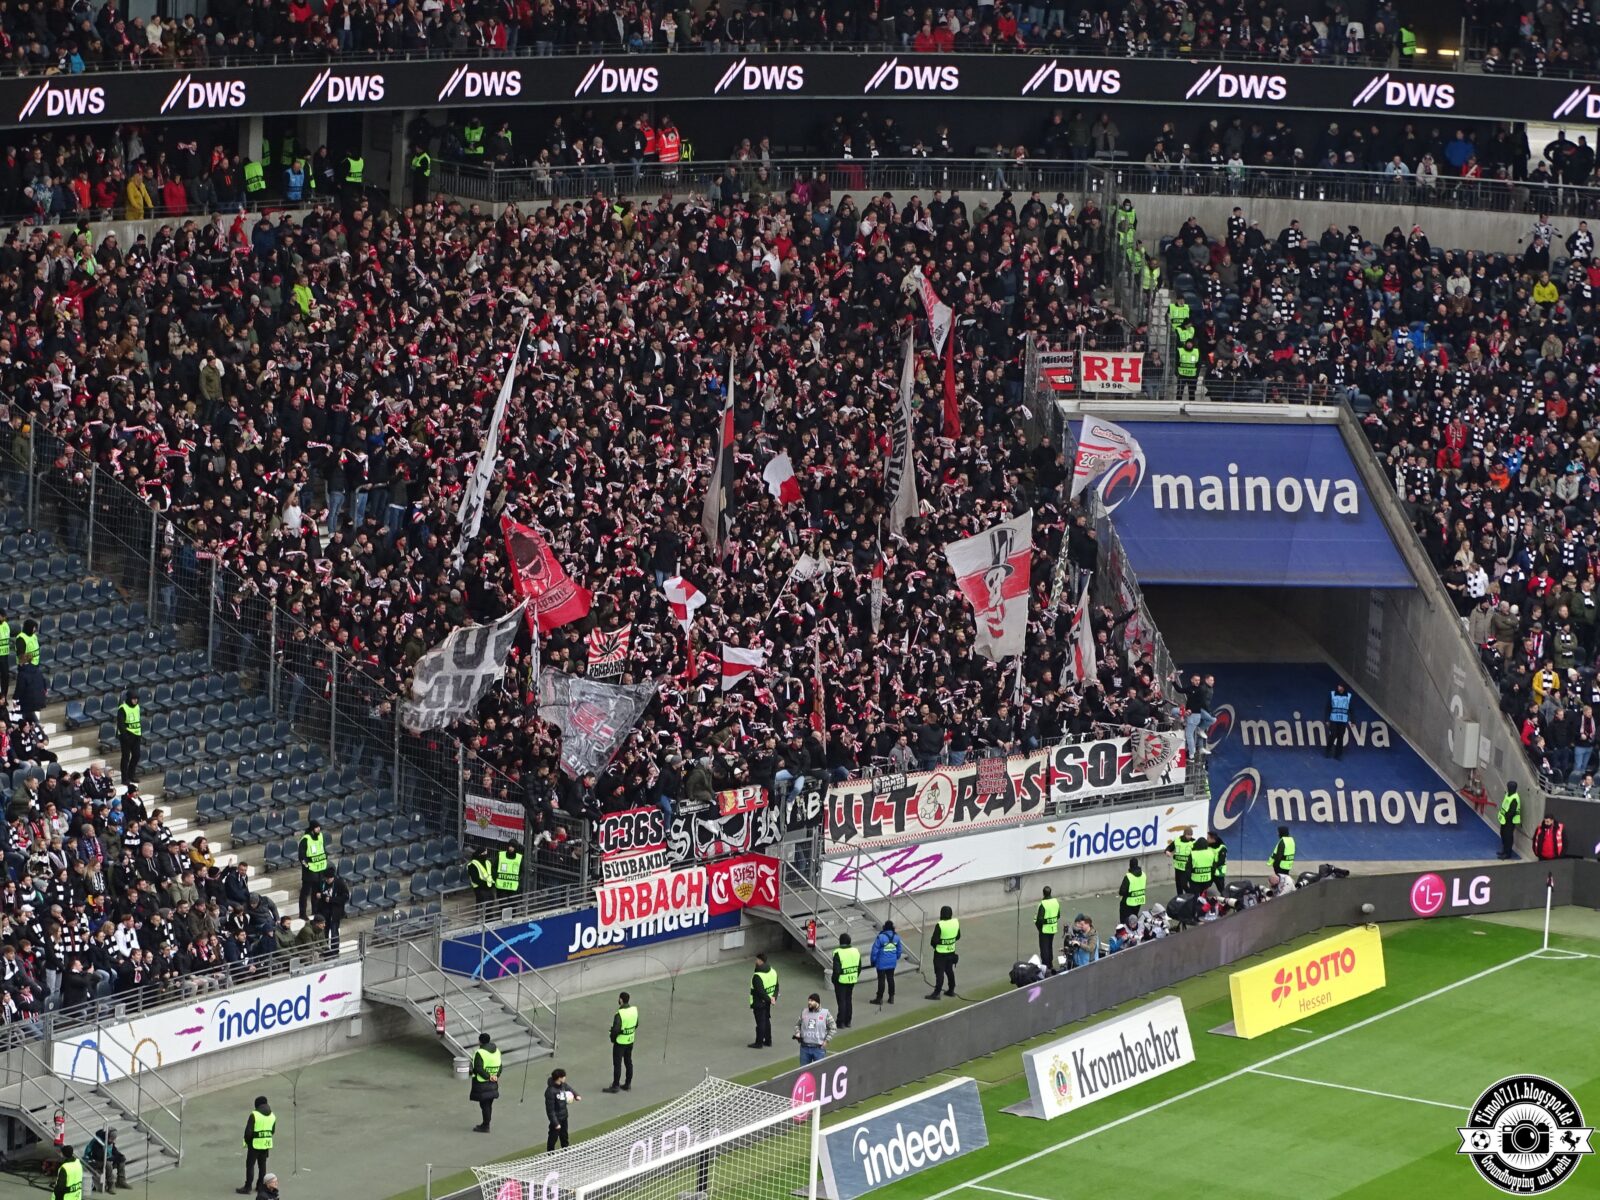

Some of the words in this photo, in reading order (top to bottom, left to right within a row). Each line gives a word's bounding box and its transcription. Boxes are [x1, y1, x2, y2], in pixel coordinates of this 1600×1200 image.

[328, 75, 385, 102] DWS
[465, 70, 522, 97] DWS
[602, 67, 658, 93] DWS
[743, 65, 803, 91] DWS
[895, 65, 959, 91] DWS
[1053, 69, 1120, 94] DWS
[1218, 74, 1287, 100] DWS
[47, 87, 105, 116] DWS
[188, 80, 246, 109] DWS
[1386, 82, 1455, 109] DWS
[1083, 356, 1141, 383] RH
[1151, 463, 1359, 514] mainova
[1240, 711, 1391, 748] mainva
[1267, 778, 1458, 825] mainova
[1062, 816, 1159, 859] indeed
[625, 870, 652, 882] STUTTGART
[600, 870, 703, 926] URBACH
[1452, 875, 1491, 907] LG
[1295, 947, 1356, 992] LOTTO
[211, 984, 311, 1042] indeed
[1298, 991, 1332, 1013] Hessen
[1071, 1021, 1183, 1098] Krombacher
[820, 1066, 848, 1102] LG
[852, 1103, 961, 1186] indeed
